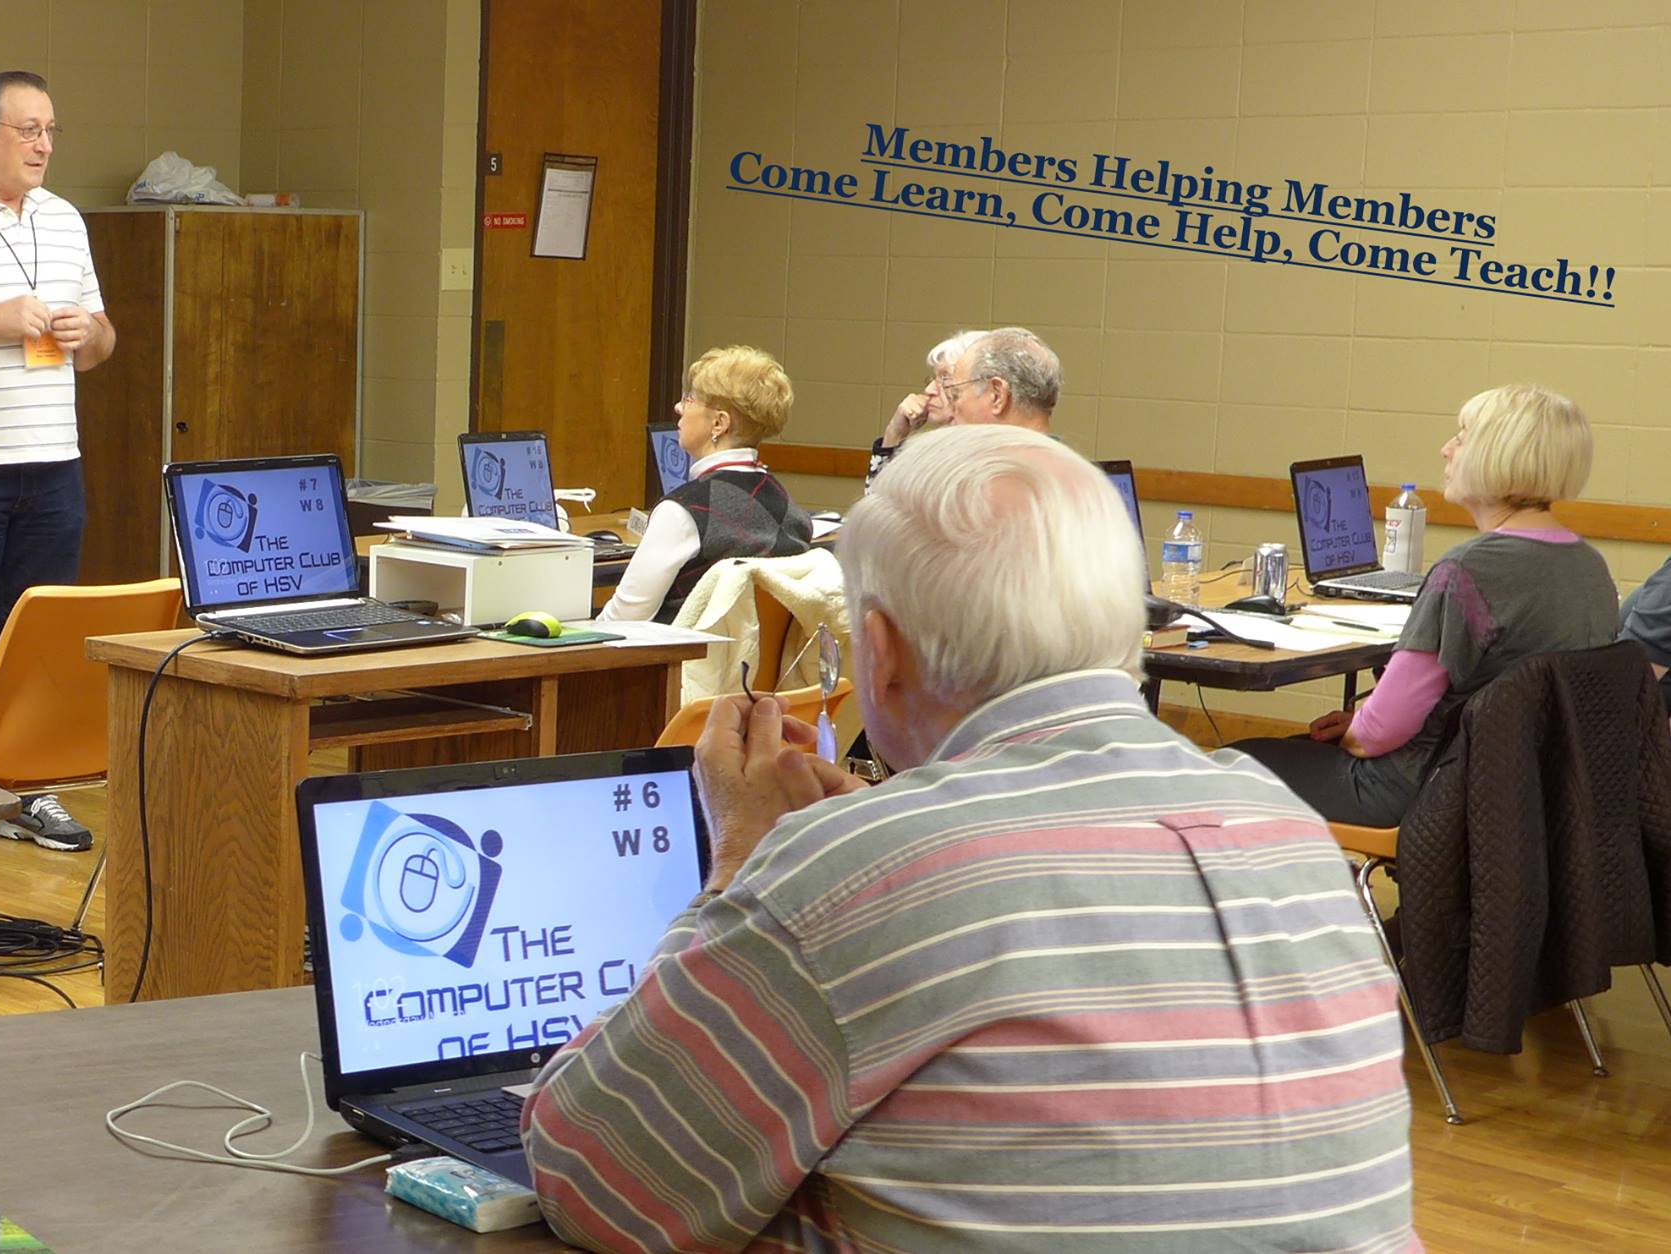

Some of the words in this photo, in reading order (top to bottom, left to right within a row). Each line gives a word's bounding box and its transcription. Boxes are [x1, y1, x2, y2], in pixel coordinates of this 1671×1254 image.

[490, 157, 497, 172] 5
[493, 216, 502, 226] NO
[503, 215, 525, 226] SMOKING
[299, 480, 308, 491] #
[310, 478, 317, 490] 7
[505, 488, 524, 500] THE
[300, 499, 312, 512] W
[316, 498, 324, 511] 8
[478, 503, 527, 516] COMPUTER
[529, 501, 553, 513] CLUB
[255, 535, 290, 551] THE
[207, 556, 295, 577] COMPUTER
[299, 552, 341, 568] CLUB
[237, 581, 259, 596] OF
[264, 574, 302, 595] HSV
[613, 783, 632, 812] #
[642, 781, 661, 808] 6
[612, 828, 640, 857] W
[652, 825, 670, 853] 8
[489, 924, 575, 962] THE
[364, 970, 586, 1027] COMPUTER
